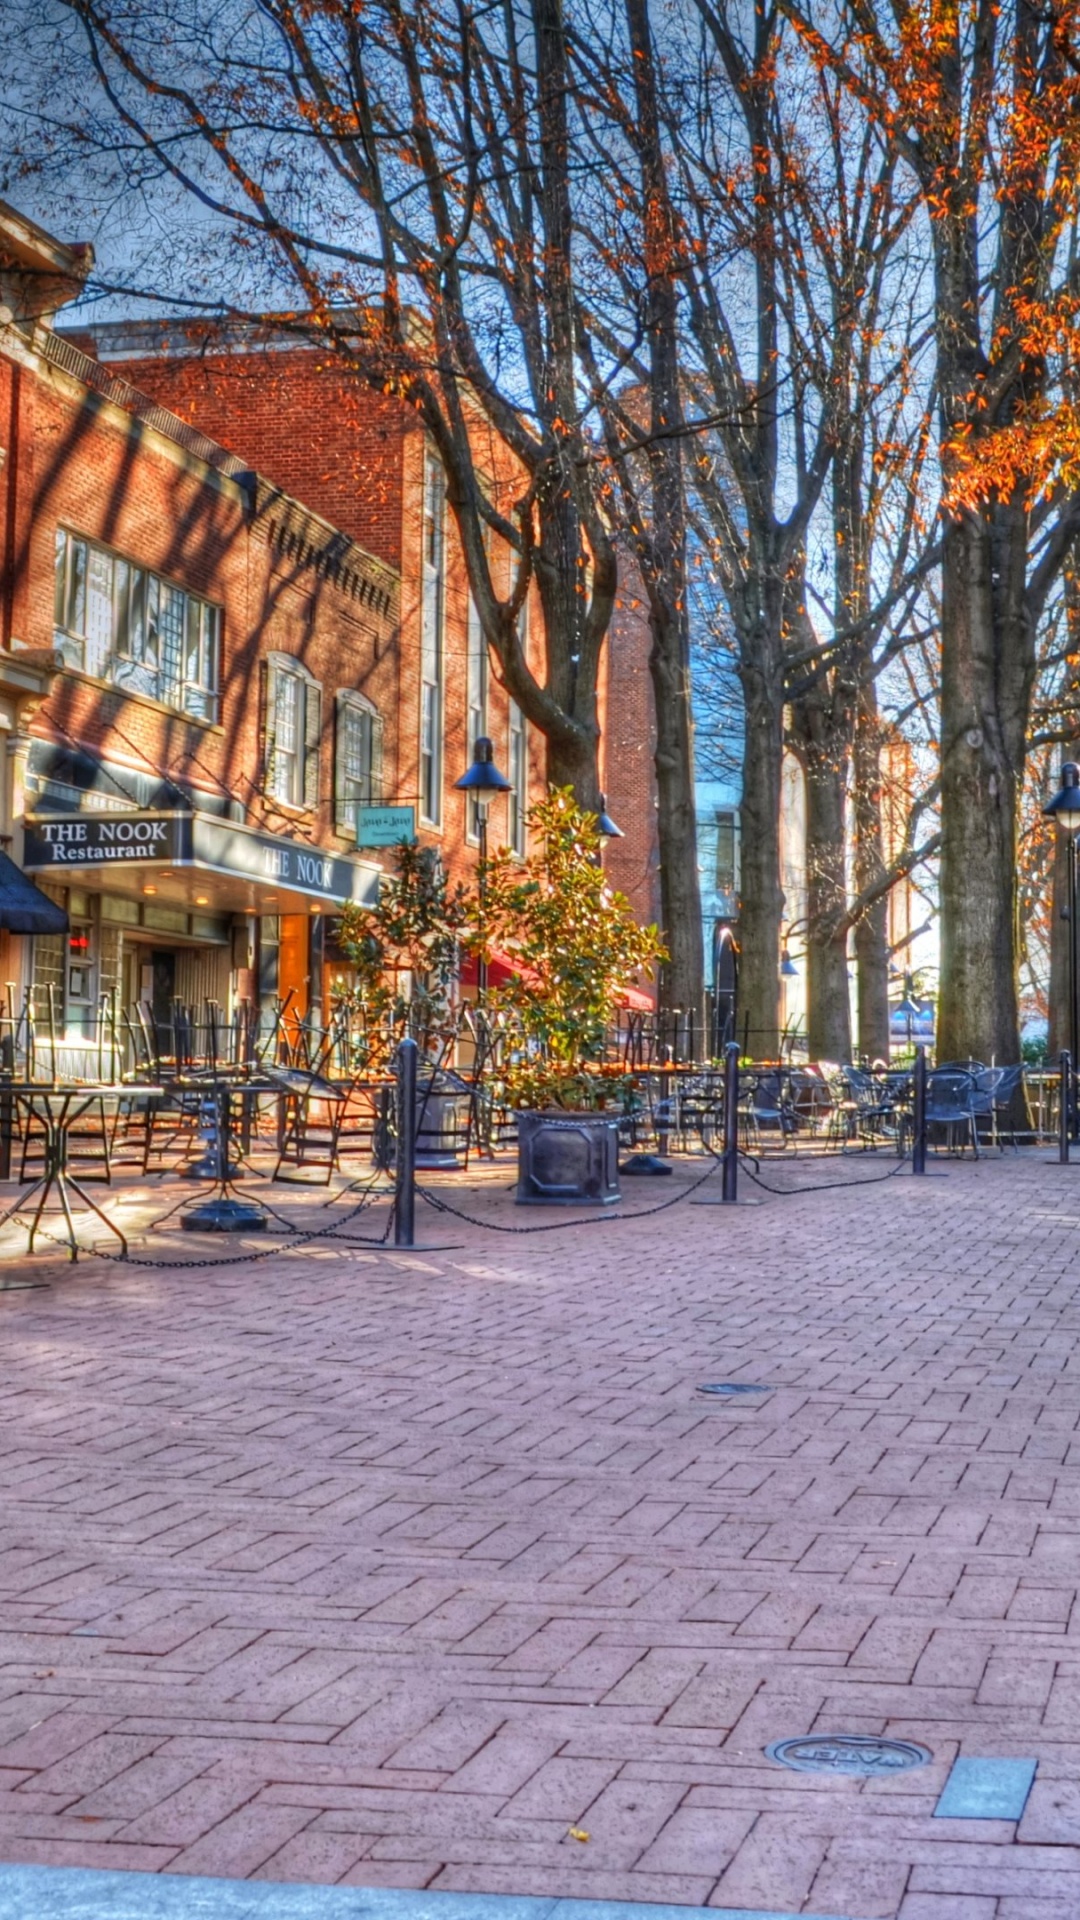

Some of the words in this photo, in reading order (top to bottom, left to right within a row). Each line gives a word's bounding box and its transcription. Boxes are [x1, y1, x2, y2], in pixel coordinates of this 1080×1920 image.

[41, 824, 87, 842] THE
[98, 822, 168, 841] NOOK
[52, 843, 156, 860] Restaurant
[263, 846, 290, 877] THE
[296, 854, 333, 888] NOOK
